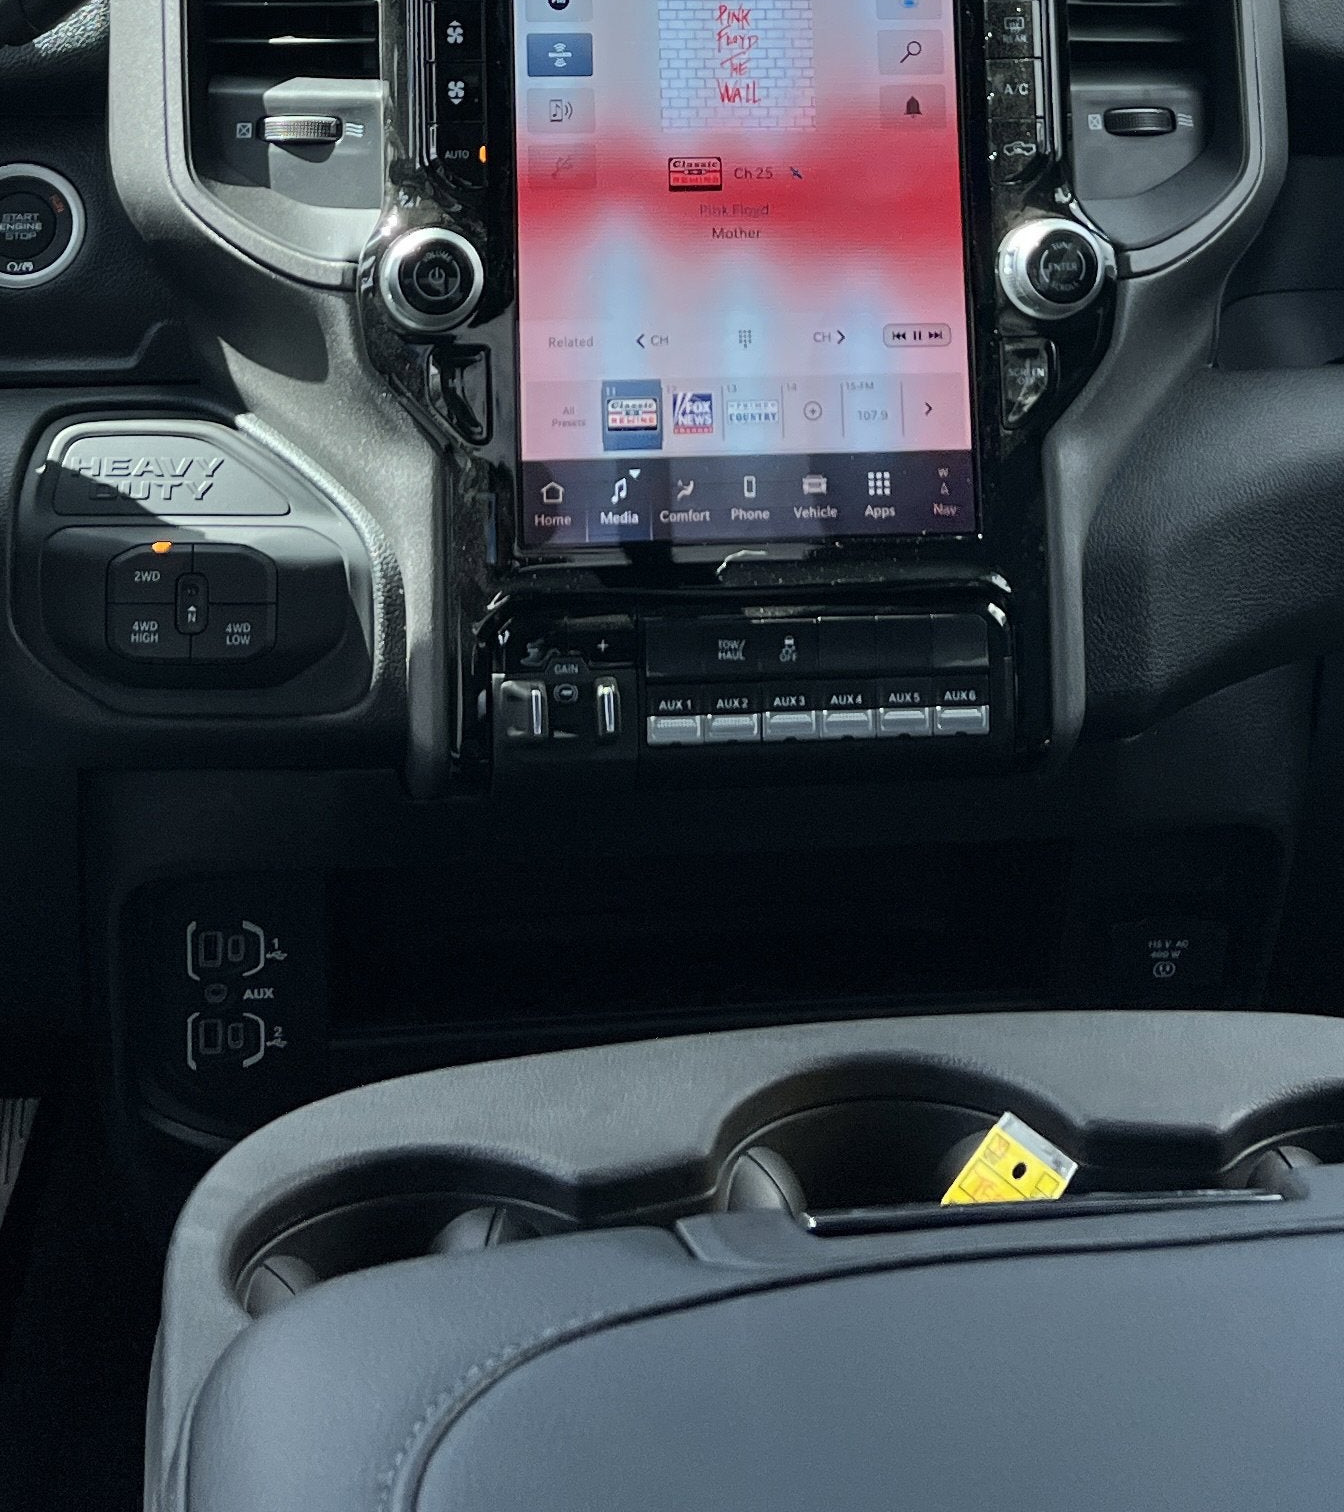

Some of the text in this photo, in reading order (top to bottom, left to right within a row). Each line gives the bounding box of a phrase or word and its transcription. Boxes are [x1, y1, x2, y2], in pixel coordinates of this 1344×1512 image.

[715, 3, 752, 26] PINK
[716, 25, 759, 52] FLOYD
[720, 51, 751, 76] THE
[716, 78, 762, 104] WALL
[1004, 83, 1029, 95] A/C
[444, 149, 470, 159] AUTO
[672, 159, 718, 169] Classic
[733, 167, 773, 180] Ch 25
[732, 203, 769, 218] Floyd
[2, 212, 40, 222] START
[4, 231, 38, 241] STOP
[711, 226, 761, 239] Mother
[548, 336, 594, 348] Related
[650, 334, 669, 347] CH
[813, 331, 831, 343] CH
[562, 406, 575, 416] All
[611, 400, 655, 410] Classic
[686, 401, 712, 413] FOX
[679, 414, 712, 425] NEWS
[729, 412, 777, 423] COUNTRY
[857, 410, 889, 421] 107.9
[69, 455, 225, 478] HEAVY
[88, 480, 214, 501] DUTY
[659, 508, 711, 523] Comfort
[730, 507, 770, 520] Phone
[793, 505, 838, 519] Vehicle
[864, 504, 896, 519] Apps
[932, 503, 958, 516] Nav
[534, 513, 572, 527] Home
[600, 510, 640, 525] Media
[134, 570, 161, 582] 2WD
[187, 611, 197, 623] N
[132, 620, 159, 632] 4WD
[225, 622, 252, 634] 4WD
[131, 632, 159, 644] HIGH
[226, 634, 251, 646] LOW
[718, 650, 746, 661] HAUL
[779, 653, 797, 663] OFF
[554, 663, 579, 674] GAIN
[773, 696, 797, 707] AUX
[830, 694, 855, 705] AUX
[888, 693, 912, 703] AUX
[944, 691, 968, 701] AUX
[659, 699, 683, 711] AUX
[716, 698, 740, 710] AUX
[272, 937, 279, 949] 1
[243, 987, 275, 1000] AUX
[273, 1026, 283, 1037] 2
